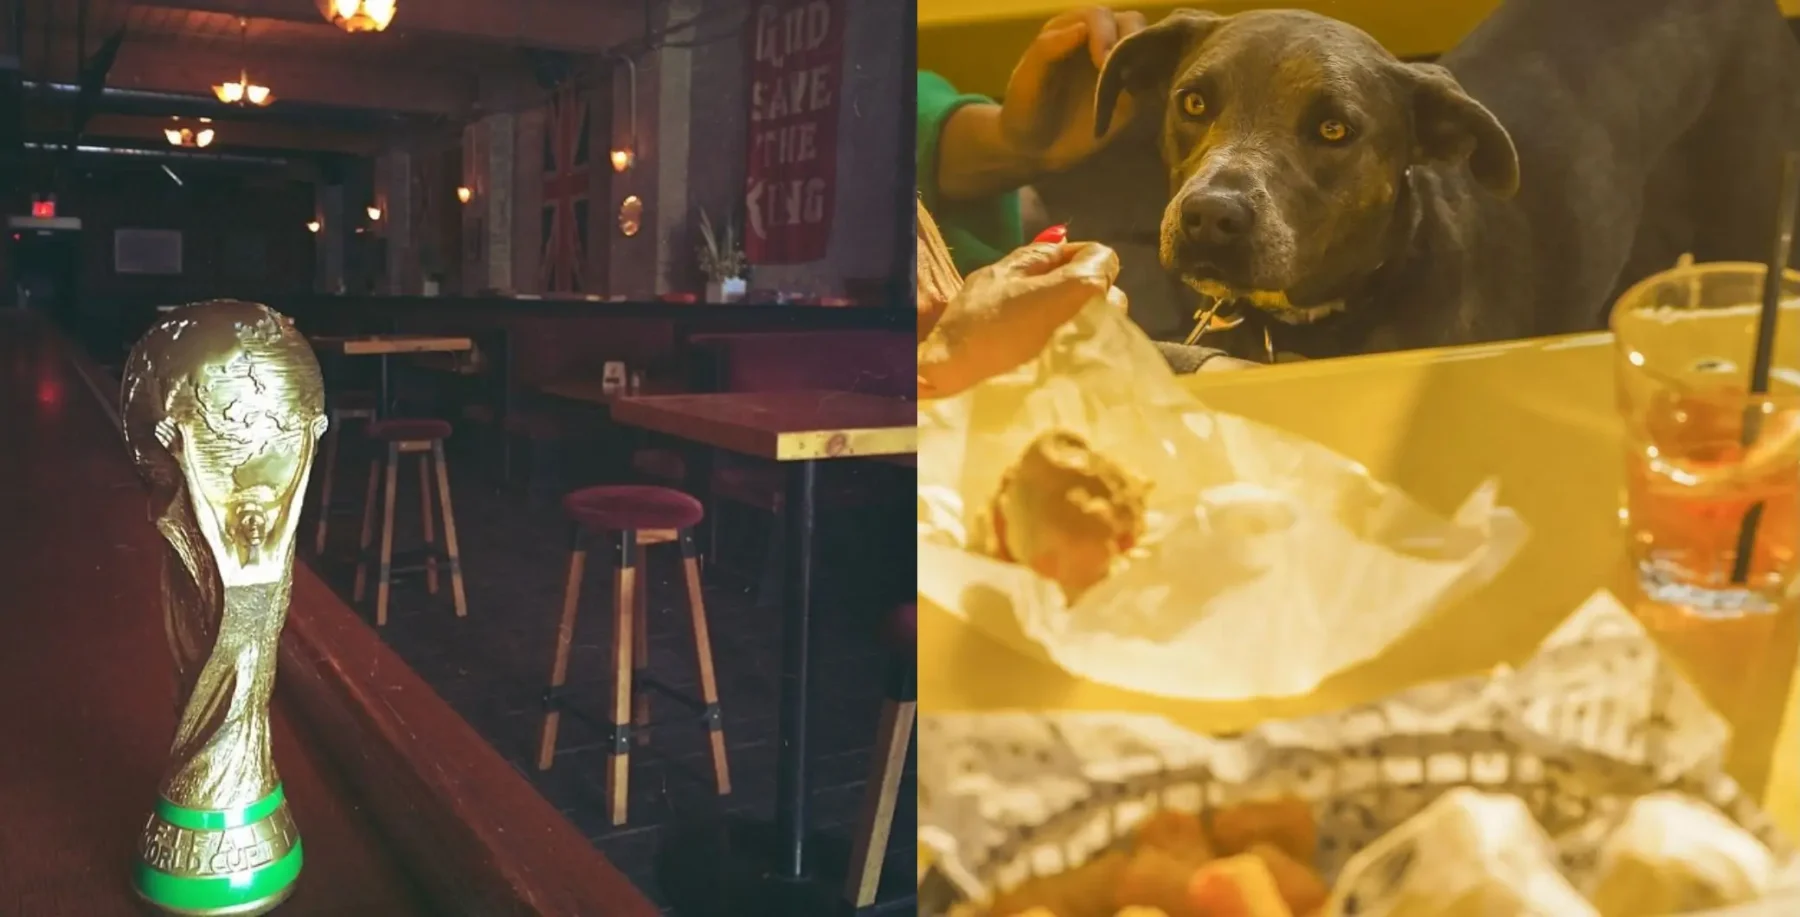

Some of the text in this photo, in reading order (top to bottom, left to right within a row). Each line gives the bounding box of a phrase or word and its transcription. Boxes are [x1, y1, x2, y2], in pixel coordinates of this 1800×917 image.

[751, 64, 832, 121] SAVE
[755, 122, 817, 167] THE
[209, 843, 263, 874] CUP
